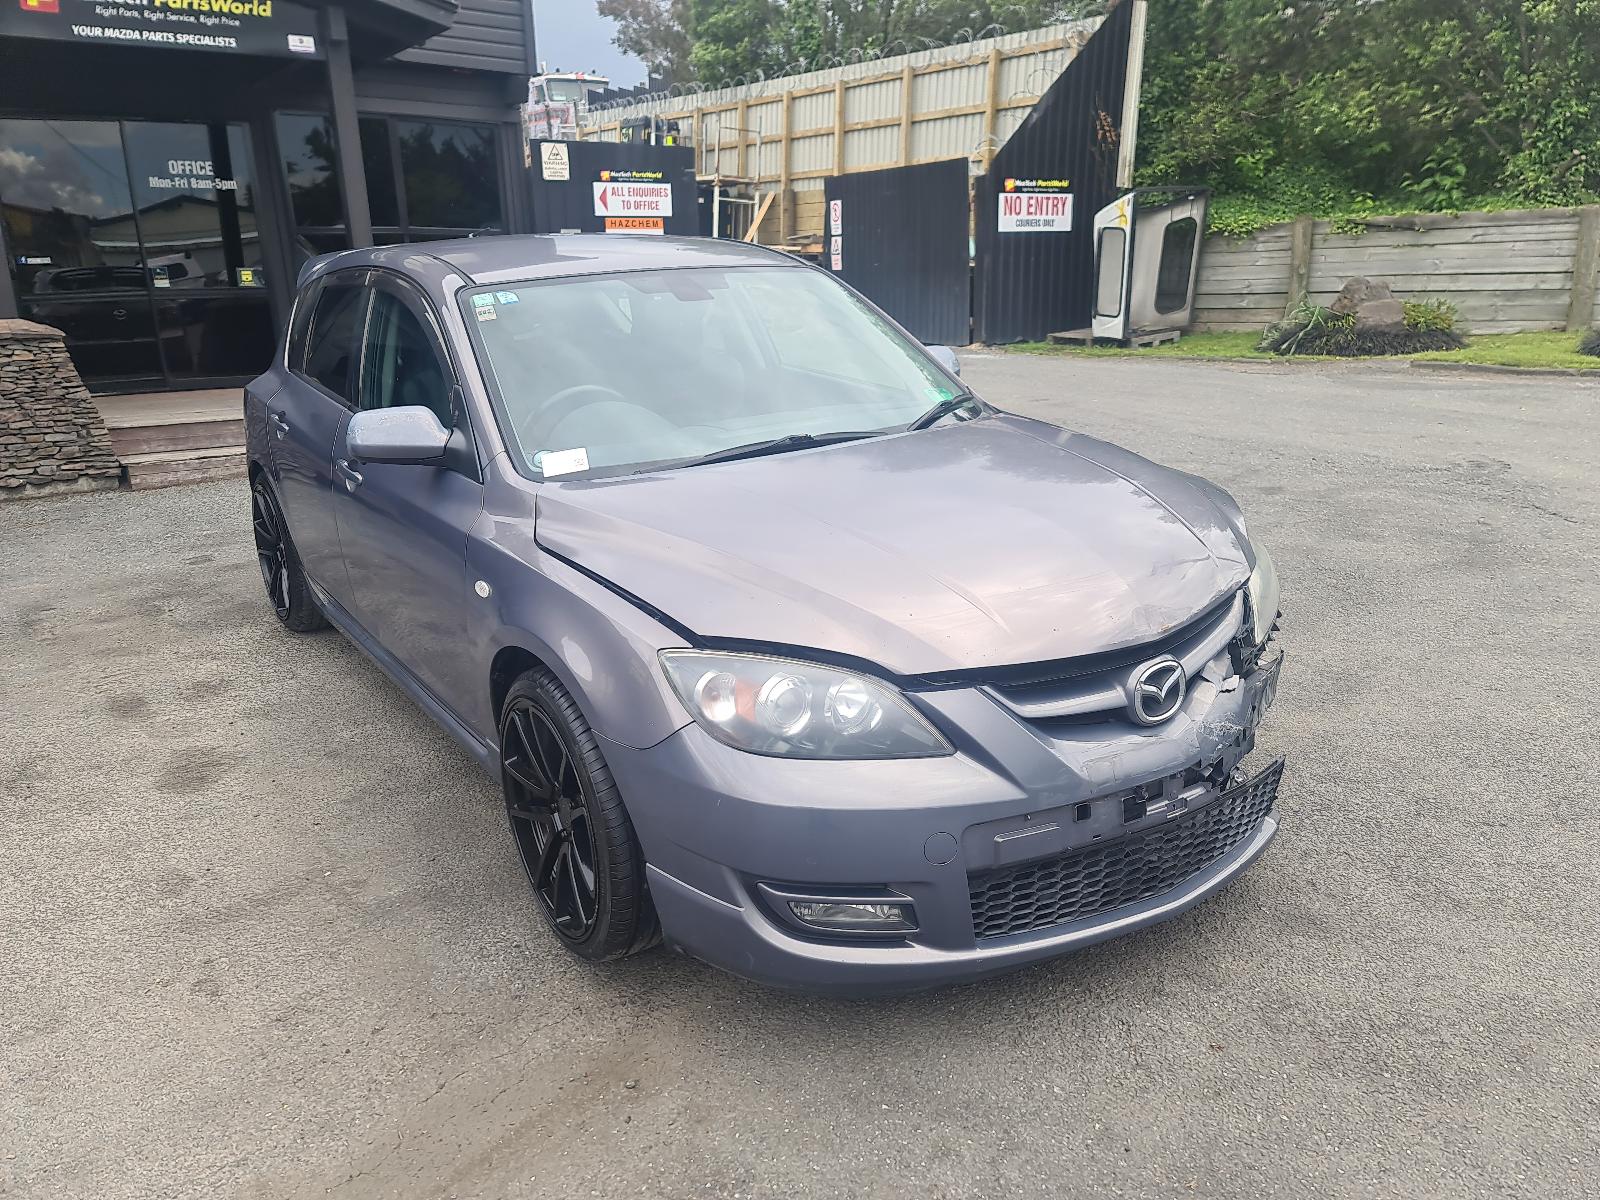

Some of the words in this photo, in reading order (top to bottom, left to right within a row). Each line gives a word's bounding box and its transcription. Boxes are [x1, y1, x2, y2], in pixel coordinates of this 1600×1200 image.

[95, 5, 117, 17] Right
[143, 10, 164, 22] Right
[200, 15, 219, 26] Right
[71, 24, 103, 37] YOUR
[104, 28, 141, 40] MAZDA
[142, 31, 175, 42] PARTS
[176, 33, 238, 48] SPECIALISTS
[167, 160, 215, 175] OFFICE
[149, 176, 188, 188] Mon-Fri
[190, 178, 238, 191] 8am-5pm
[611, 186, 625, 197] ALL
[628, 186, 669, 198] ENQUIRIES
[621, 199, 632, 210] TO
[634, 200, 660, 211] OFFICE
[1004, 195, 1022, 216] NO
[1027, 195, 1068, 216] ENTRY
[610, 219, 659, 228] HAZCHEM
